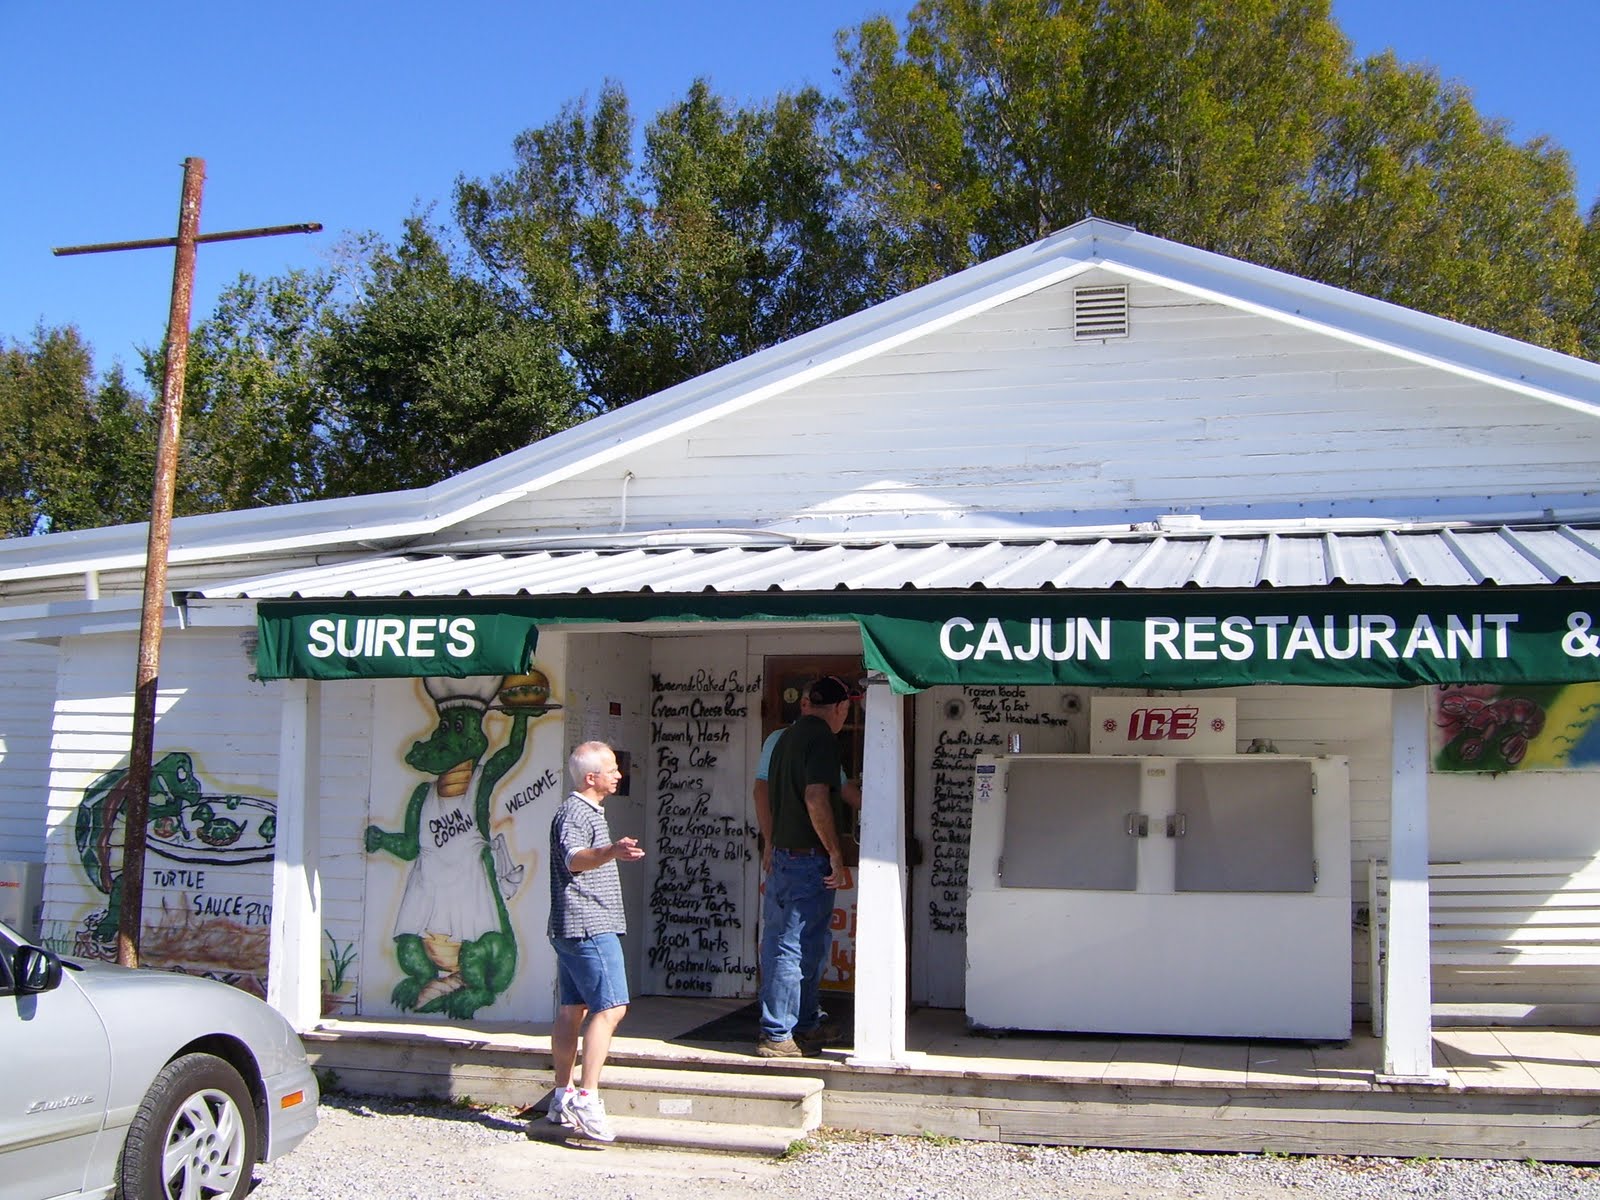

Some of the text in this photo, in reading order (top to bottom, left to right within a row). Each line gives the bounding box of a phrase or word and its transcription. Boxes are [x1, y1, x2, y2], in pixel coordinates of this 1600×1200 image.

[307, 618, 476, 658] SUIRE'S
[939, 611, 1600, 661] CAJUN RESTAURANT &
[696, 669, 727, 692] Baked
[729, 670, 762, 693] Sweet
[963, 685, 1026, 698] Frozen Foods
[651, 693, 748, 717] Cream Cheese Bars
[971, 698, 1030, 713] Ready To Eat
[1005, 712, 1024, 724] Heat
[1127, 707, 1199, 741] ICE
[651, 721, 730, 747] Heavenly Hash
[657, 746, 718, 773] Fig Cake
[505, 769, 557, 814] WELCOME
[657, 768, 703, 791] Brownies
[658, 792, 710, 816] Pecan Pie
[429, 808, 464, 834] CAJUN
[434, 814, 473, 848] COOKIN
[658, 816, 757, 838] Rice Krispie Treats
[656, 837, 751, 860] Peanut Butter Balls
[658, 856, 711, 880] Fig Tarts
[153, 871, 205, 890] TURTLE
[700, 878, 728, 895] Tarts
[193, 894, 243, 916] SAUCE
[650, 891, 737, 914] Blackberry Tarts
[652, 906, 742, 929] Strawberry Tarts
[653, 923, 729, 953] Peach Tarts
[723, 956, 757, 981] Fudge
[665, 972, 713, 993] Cookies
[26, 1093, 96, 1115] Sunfire
